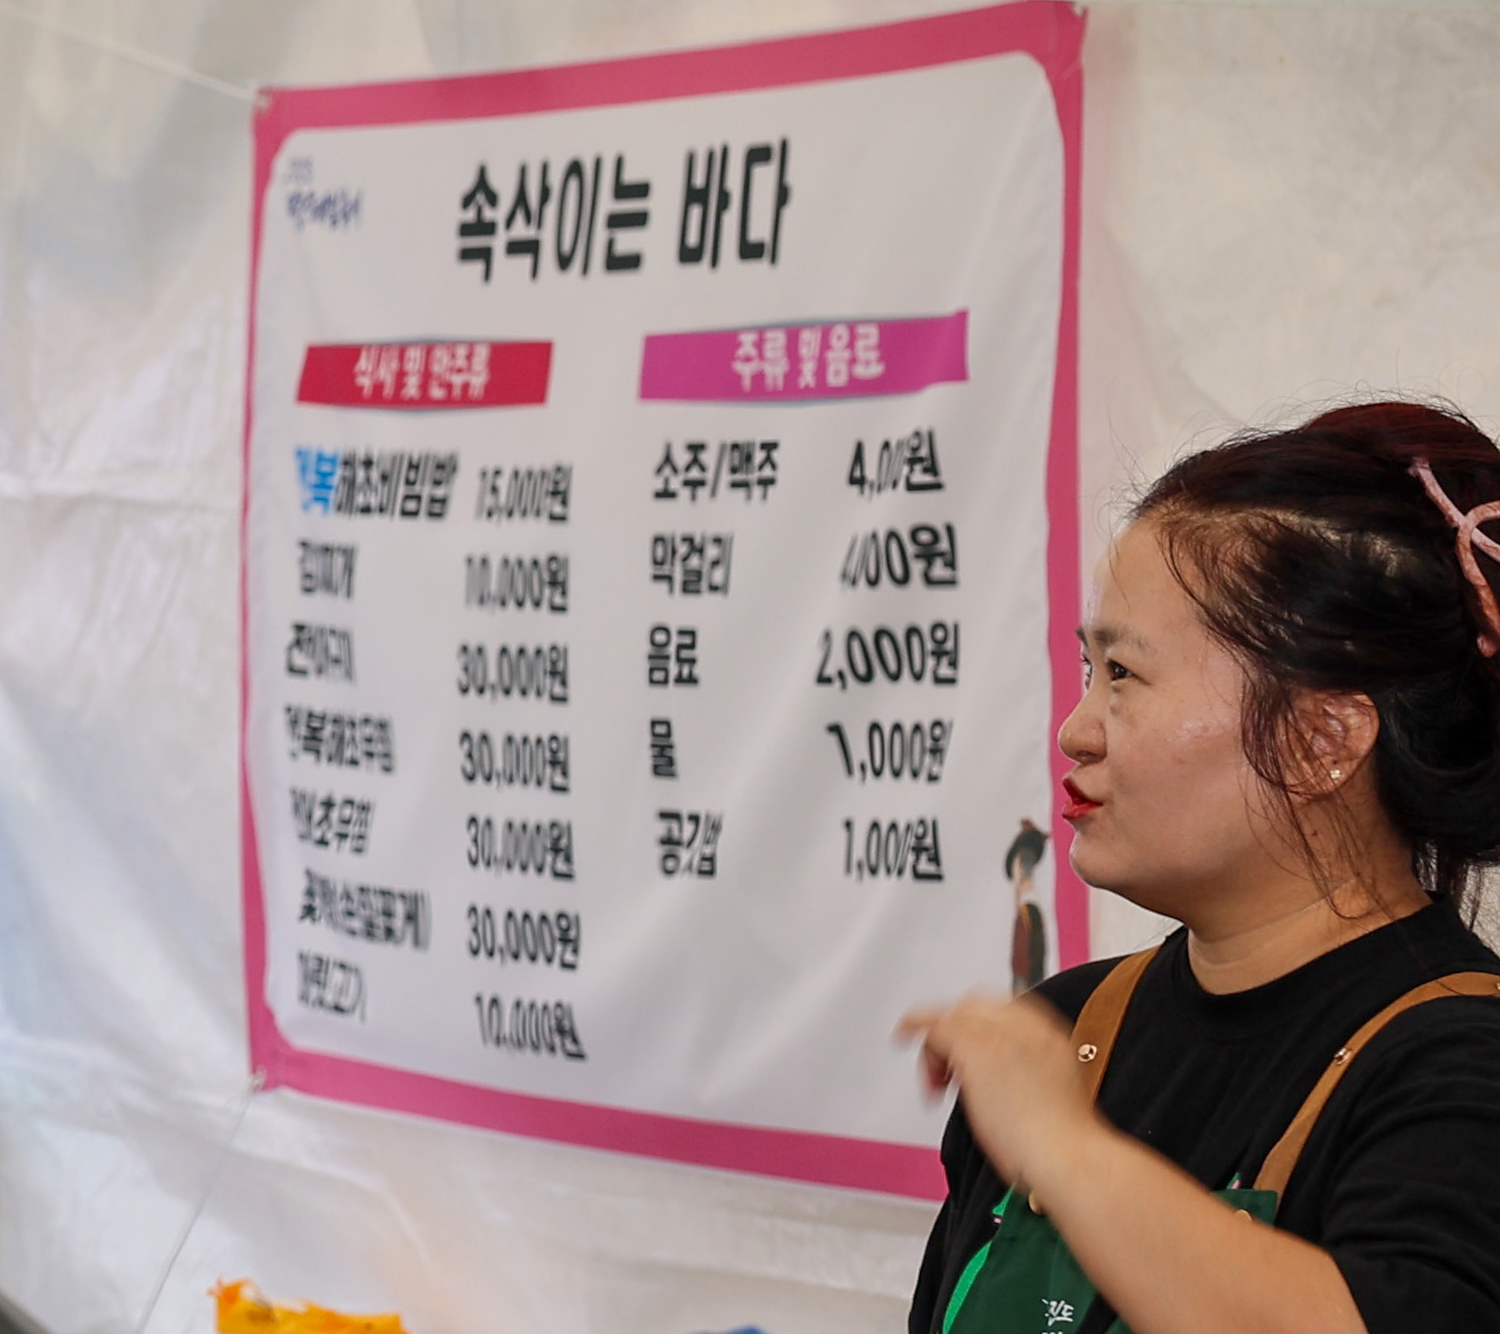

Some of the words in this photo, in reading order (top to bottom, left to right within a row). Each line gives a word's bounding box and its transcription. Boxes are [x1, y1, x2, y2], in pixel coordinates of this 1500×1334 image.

[457, 155, 651, 284] 속삭이는
[678, 135, 791, 270] 바다
[731, 330, 790, 393] 주류
[825, 322, 887, 387] 음료
[652, 440, 781, 503] 소주/맥주
[651, 532, 735, 597] 막걸리
[457, 644, 570, 706] 30,000원
[647, 624, 700, 688] 음료
[815, 621, 961, 692] 2,000원
[458, 730, 572, 793] 30,000원
[649, 717, 678, 780] 물
[825, 719, 954, 784] 1,000원
[842, 818, 946, 884] 1,00원
[466, 904, 581, 971] 30,000원
